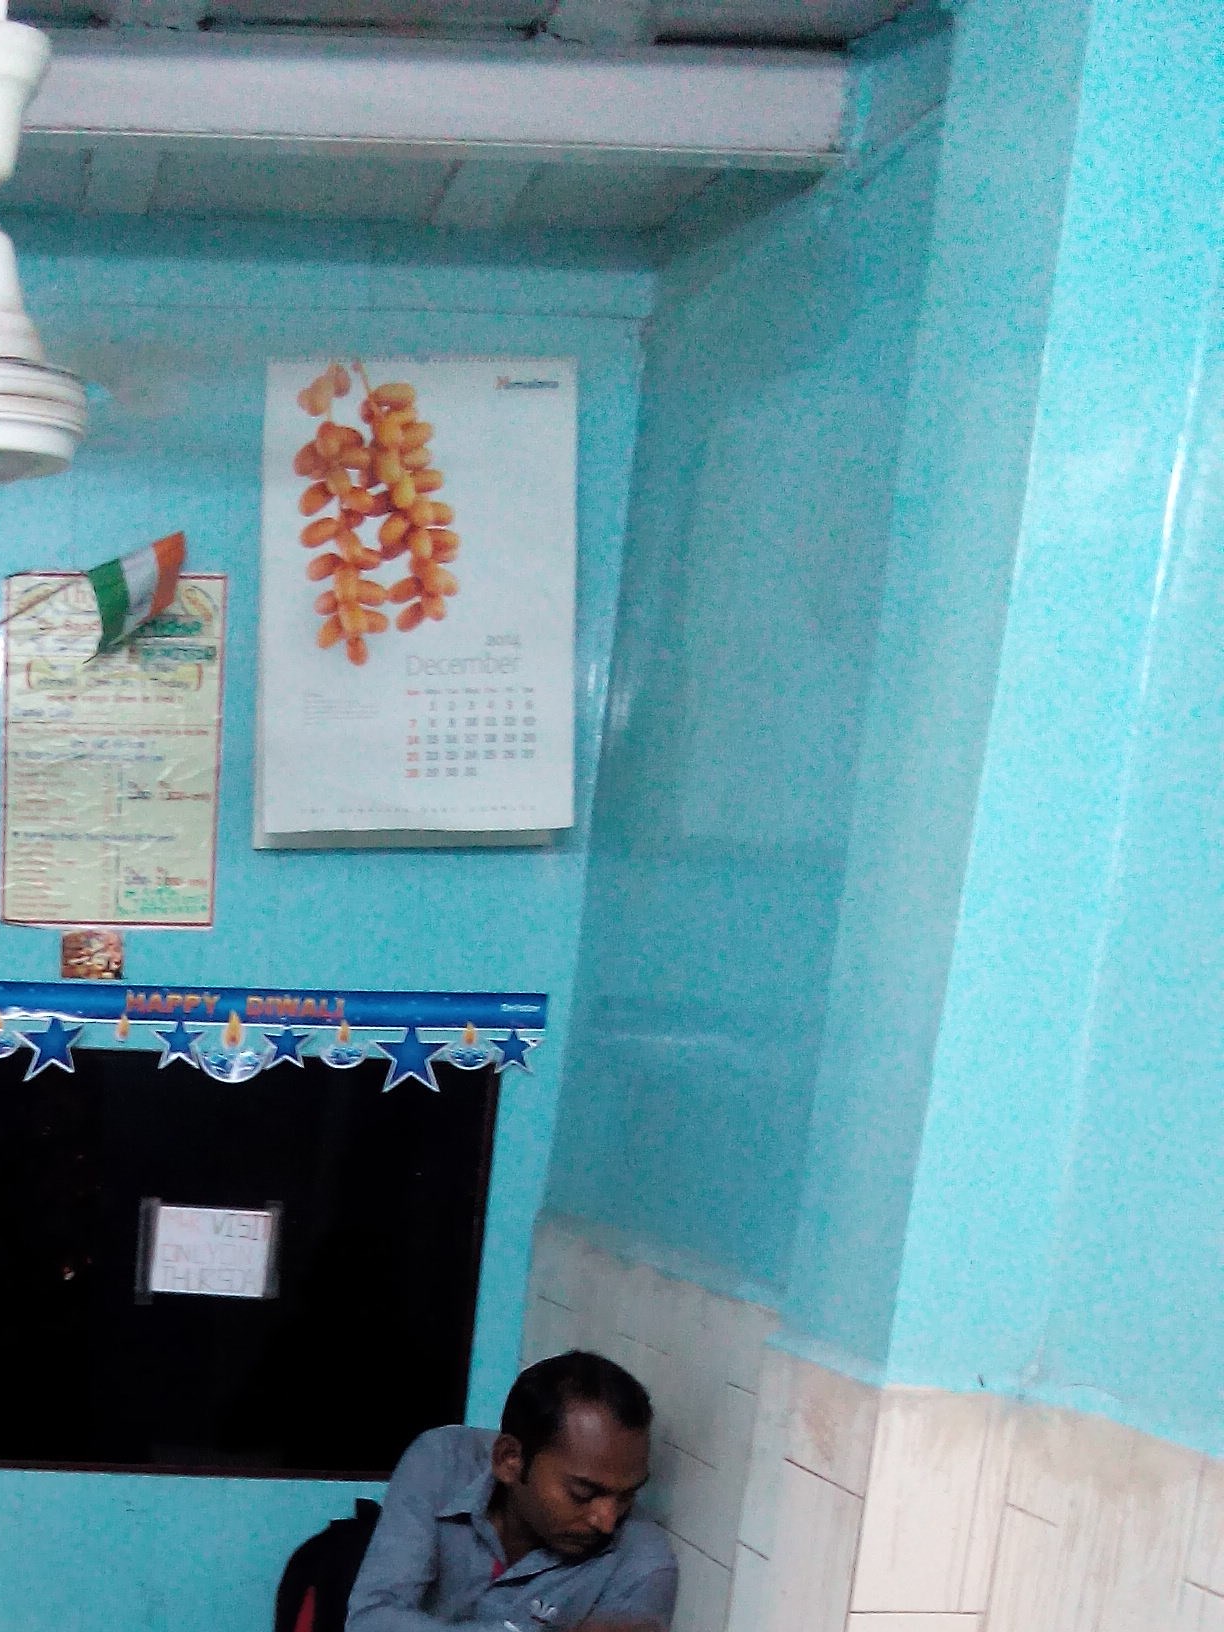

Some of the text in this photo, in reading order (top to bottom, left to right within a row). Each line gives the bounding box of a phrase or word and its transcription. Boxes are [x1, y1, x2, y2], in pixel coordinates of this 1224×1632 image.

[406, 652, 522, 677] December
[126, 989, 345, 1019] HAPPY DIWALI
